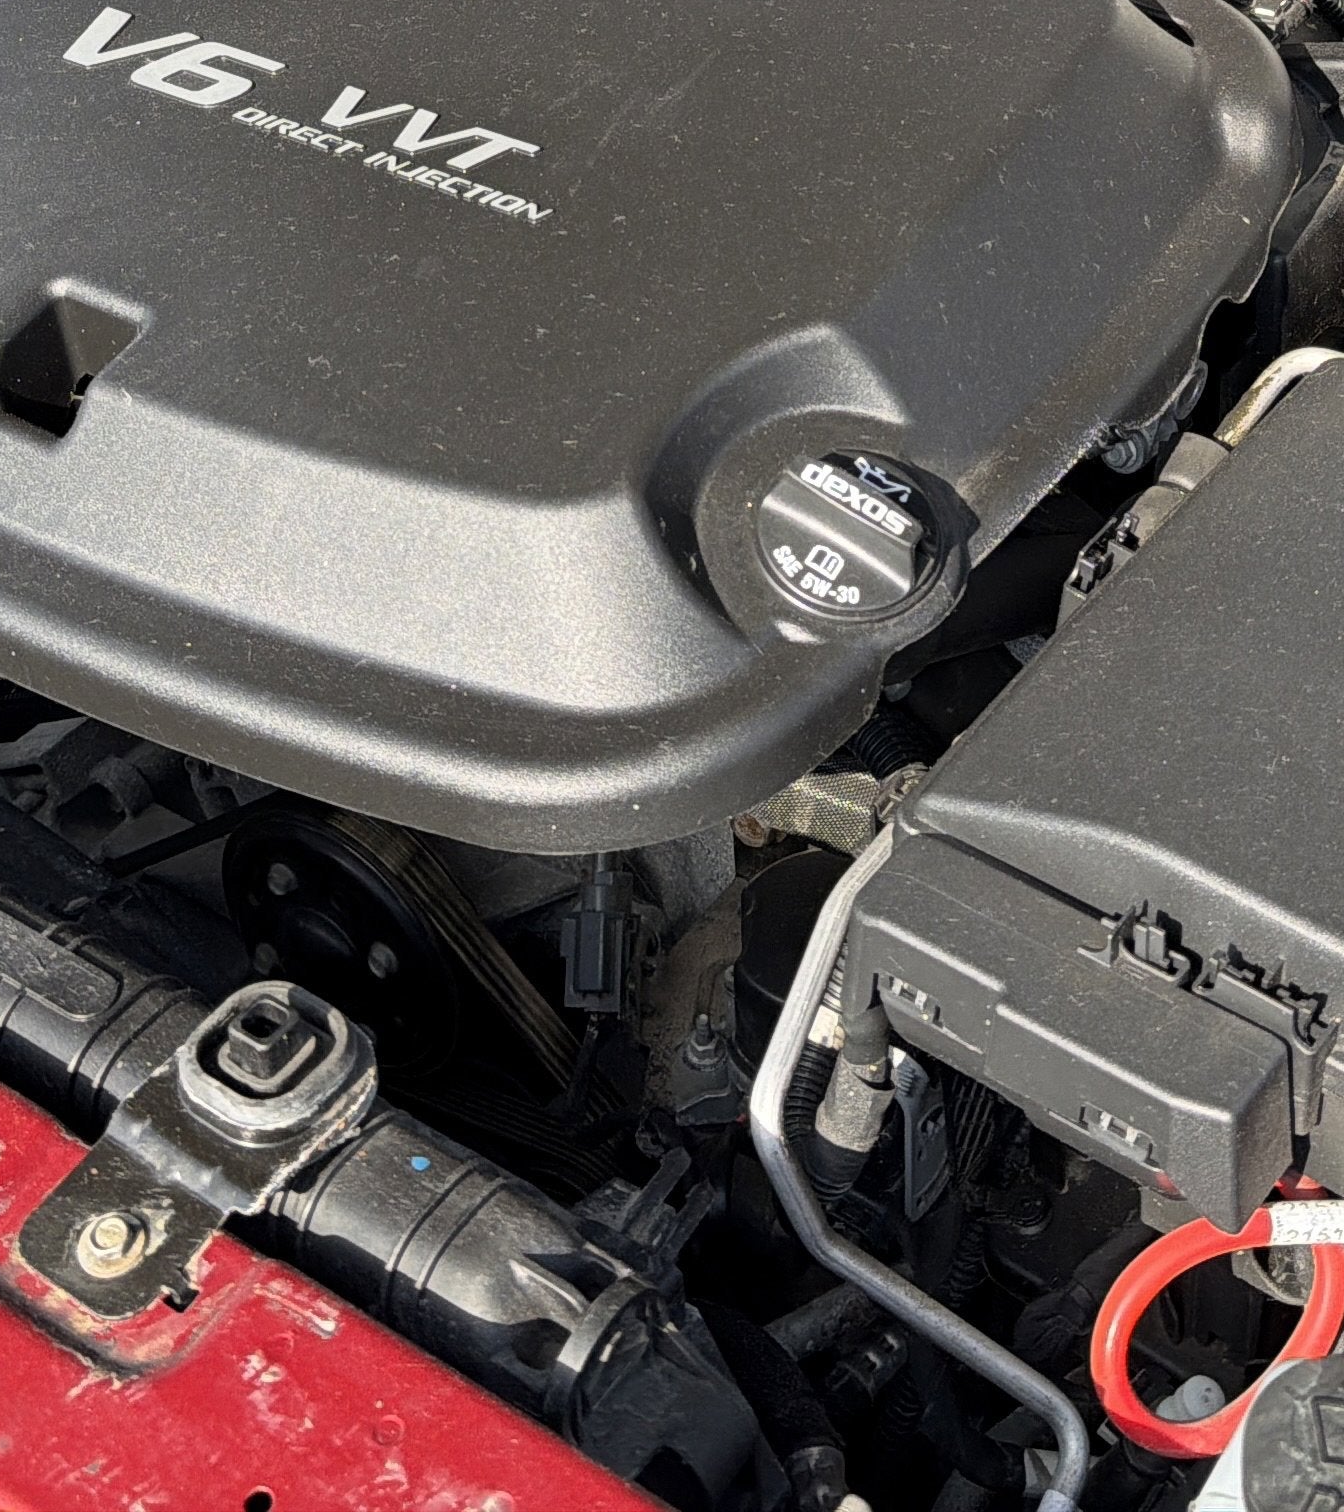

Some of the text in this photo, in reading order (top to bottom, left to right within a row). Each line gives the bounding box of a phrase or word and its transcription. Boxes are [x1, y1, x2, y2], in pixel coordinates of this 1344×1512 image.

[62, 6, 544, 174] V6 VVT
[232, 106, 555, 224] DIRECT INJECTION
[800, 463, 913, 535] dexos
[772, 545, 860, 605] SAE 5W-30
